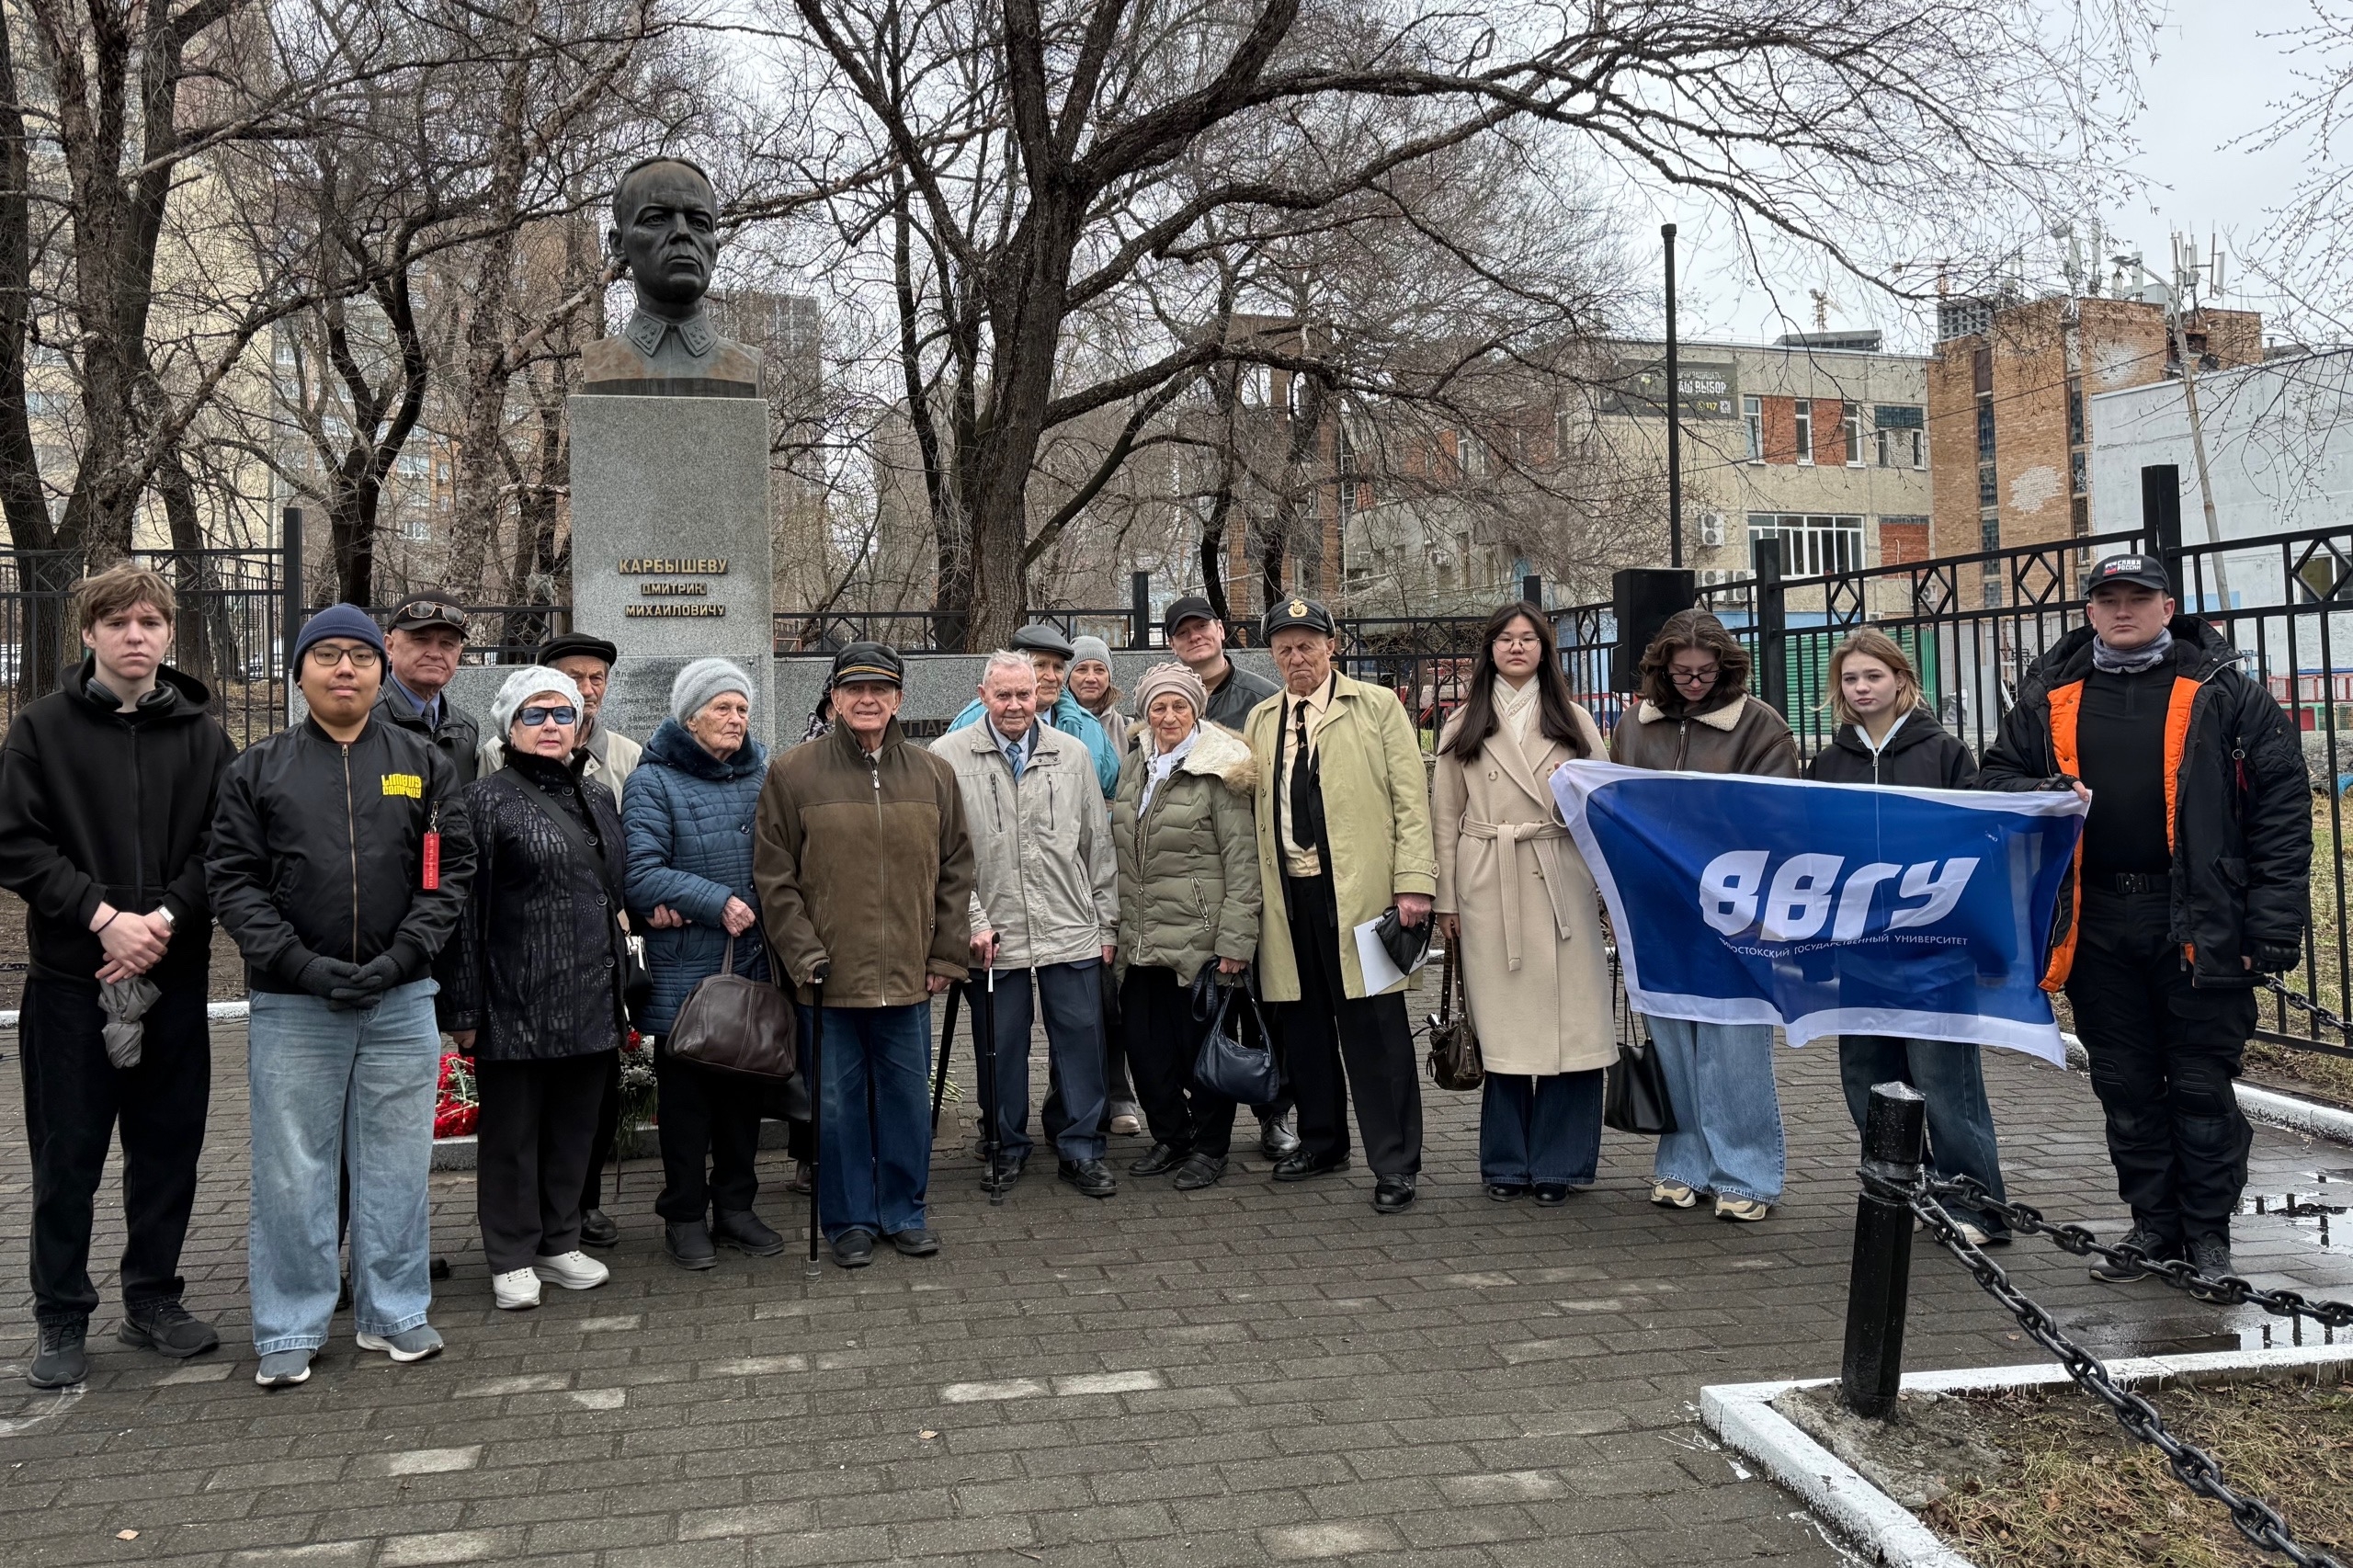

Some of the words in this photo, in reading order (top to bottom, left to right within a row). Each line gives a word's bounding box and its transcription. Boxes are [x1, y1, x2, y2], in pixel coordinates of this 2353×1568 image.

[1678, 380, 1692, 393] АШ
[1695, 381, 1727, 394] ВЫБОР
[619, 559, 727, 574] КАРБЫШЕВУ
[642, 584, 707, 595] ДМИТРИЮ
[381, 773, 422, 788] LIMBUS
[1894, 934, 1968, 947] УНИВЕРСИТЕТ
